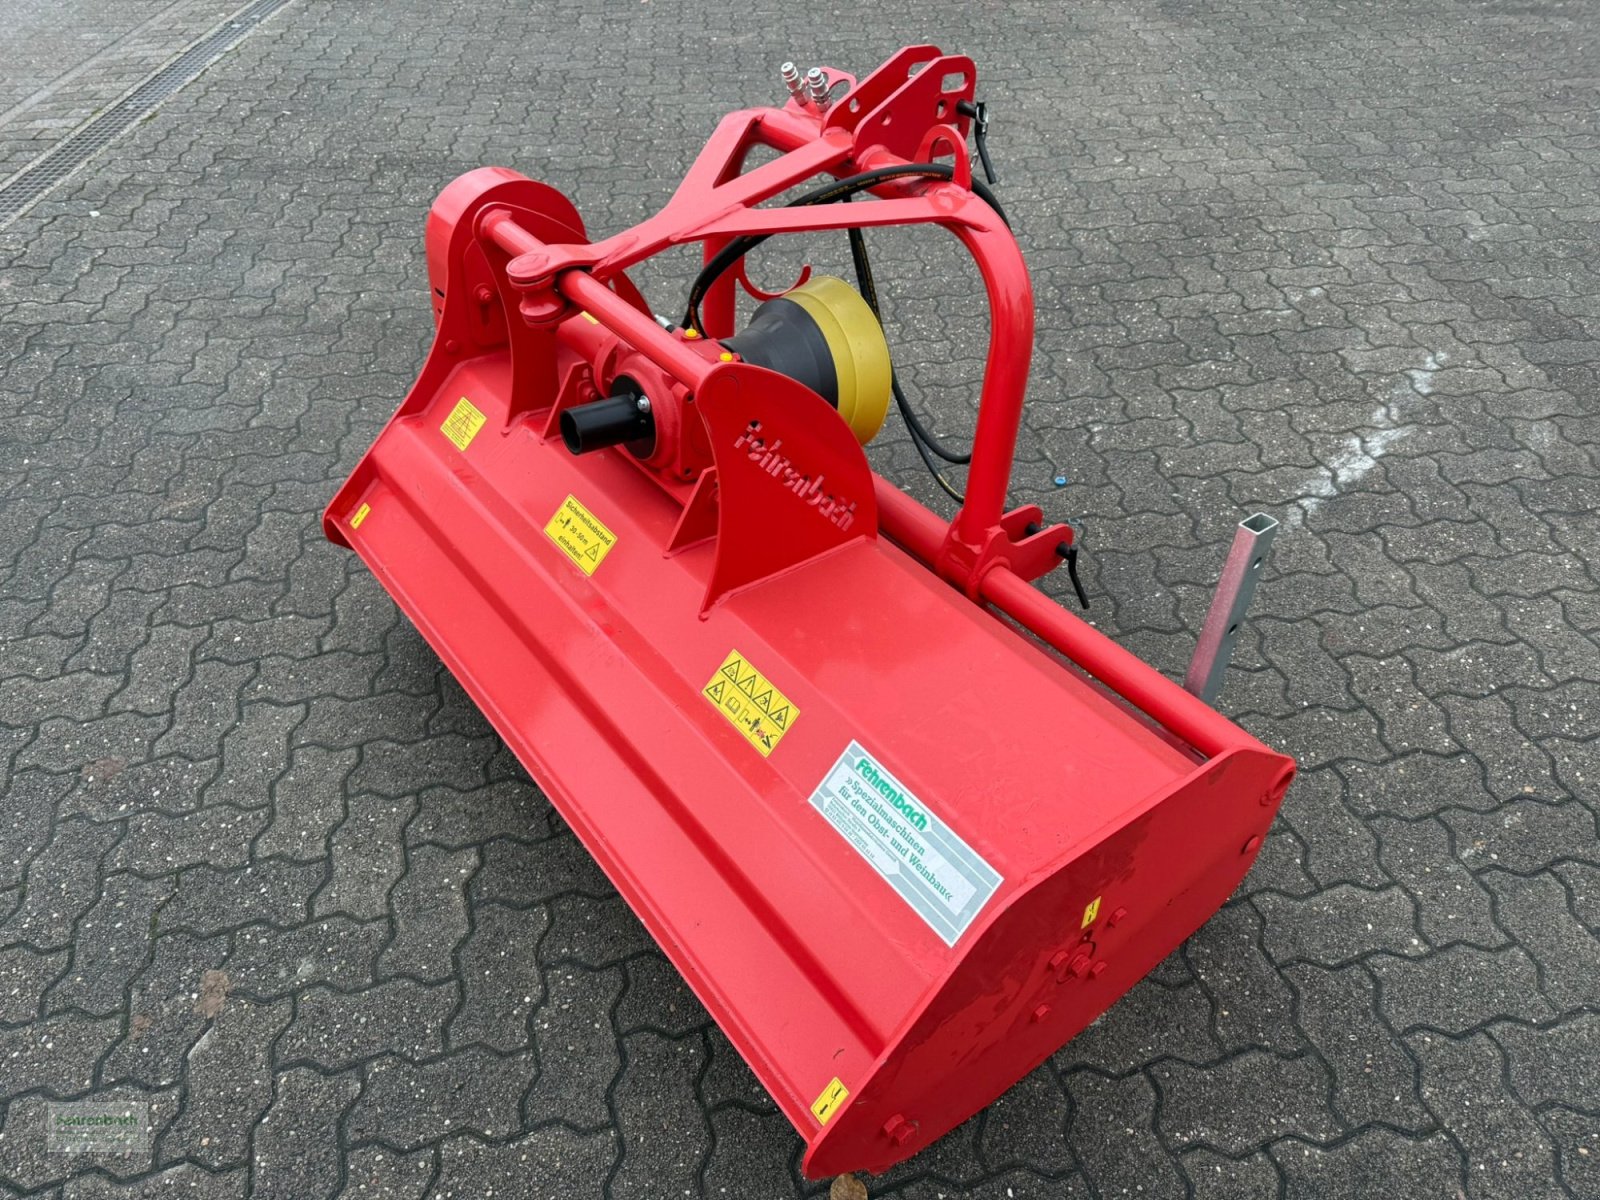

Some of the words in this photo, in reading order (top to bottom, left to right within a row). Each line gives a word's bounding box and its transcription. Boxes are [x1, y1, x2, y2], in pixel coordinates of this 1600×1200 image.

[558, 535, 583, 560] einhalten!
[566, 501, 612, 546] Sicherheitsabstand
[838, 786, 852, 801] für
[851, 798, 867, 817] den
[867, 814, 890, 839] Obst-
[890, 837, 909, 857] und
[855, 758, 927, 831] Fehrenbach
